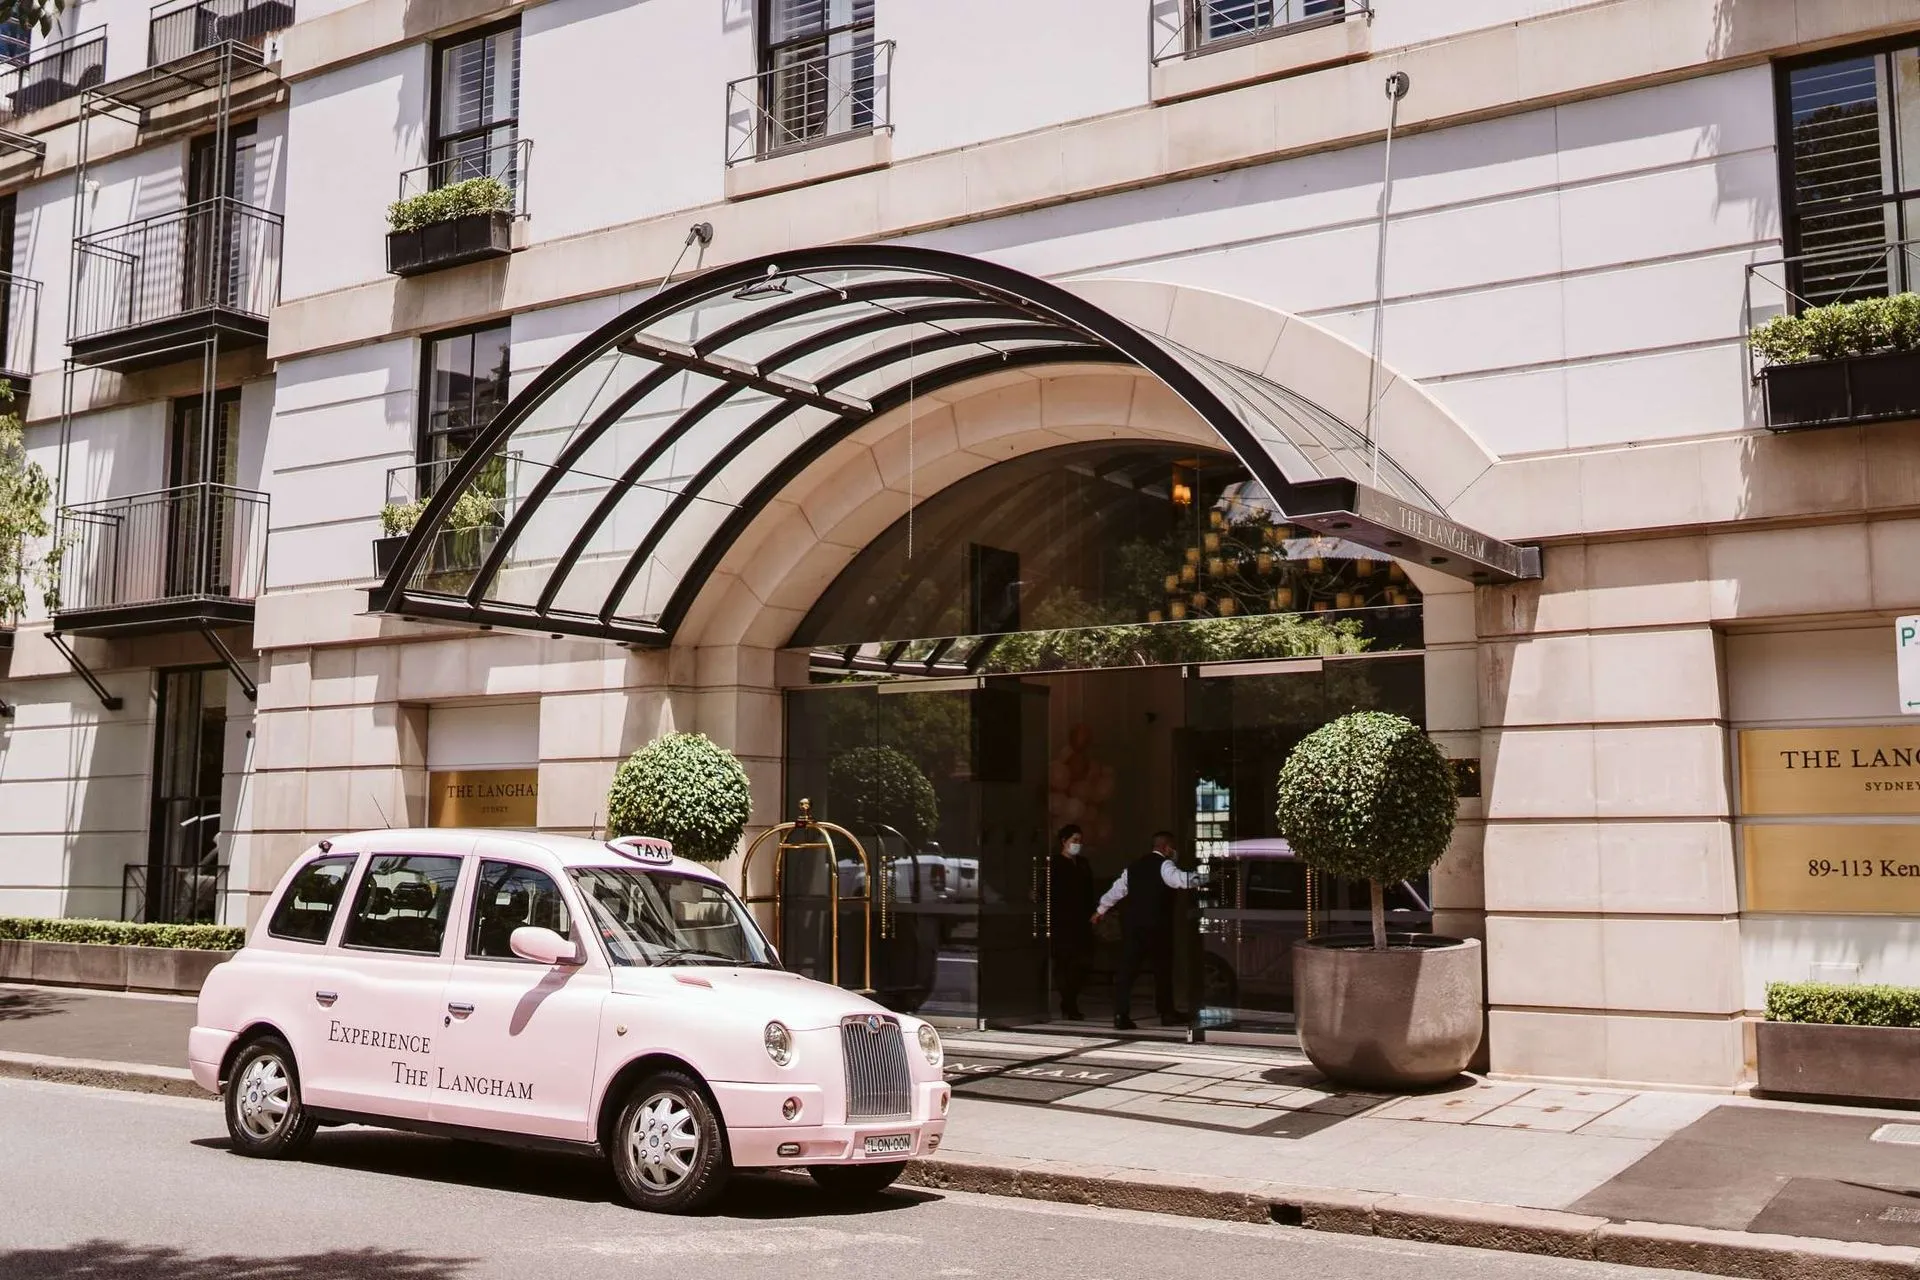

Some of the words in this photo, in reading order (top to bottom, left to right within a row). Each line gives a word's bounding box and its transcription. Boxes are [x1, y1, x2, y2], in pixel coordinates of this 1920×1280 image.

[1398, 506, 1424, 535] THE
[1428, 518, 1485, 558] LANGHAM
[1901, 627, 1916, 647] P
[1780, 749, 1841, 769] THE
[1850, 748, 1920, 768] LAN
[447, 784, 474, 799] THE
[477, 783, 538, 798] LANGHA
[633, 843, 669, 859] TAXI
[1808, 859, 1873, 877] 89-113
[328, 1020, 431, 1054] EXPERIENCE
[391, 1061, 428, 1087] THE
[437, 1067, 534, 1100] LANGHAM
